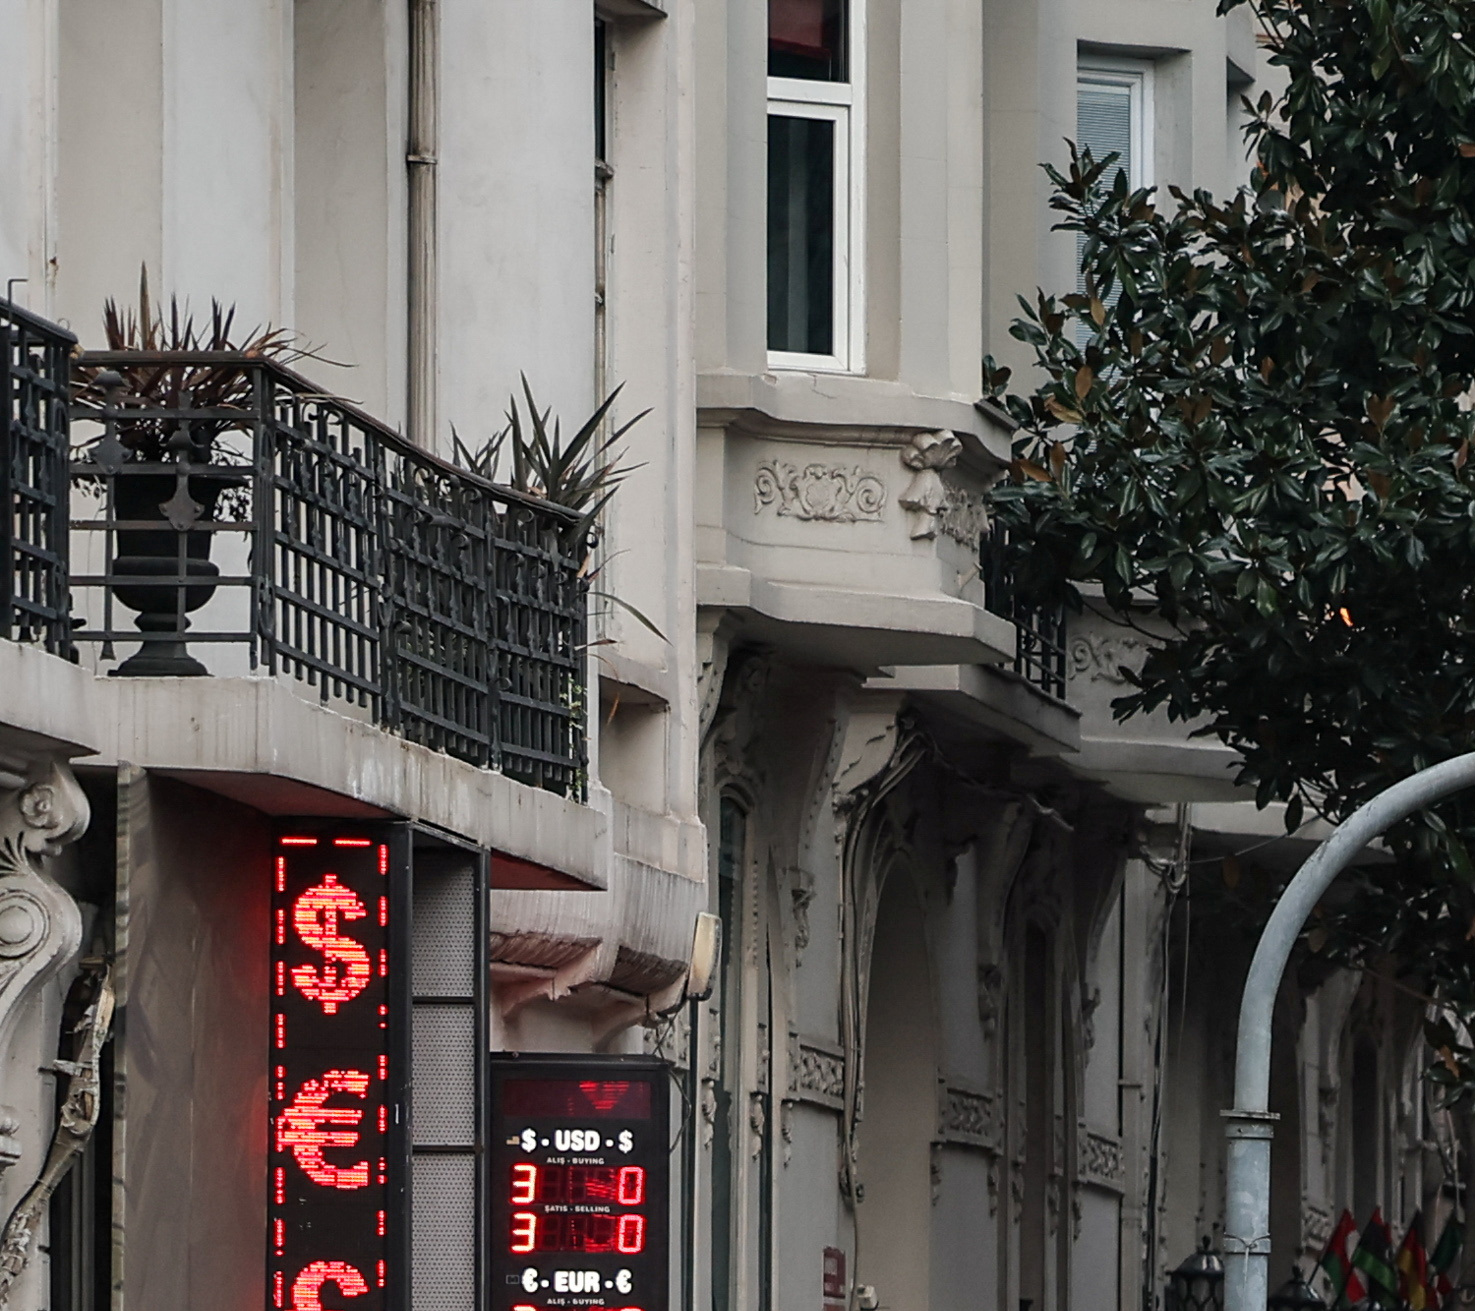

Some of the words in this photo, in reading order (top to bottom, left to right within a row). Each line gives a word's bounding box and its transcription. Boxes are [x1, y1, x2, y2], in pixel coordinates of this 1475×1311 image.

[291, 874, 370, 1014] $
[276, 1070, 370, 1189] €
[555, 1130, 601, 1151] USD
[554, 1270, 600, 1293] EUR
